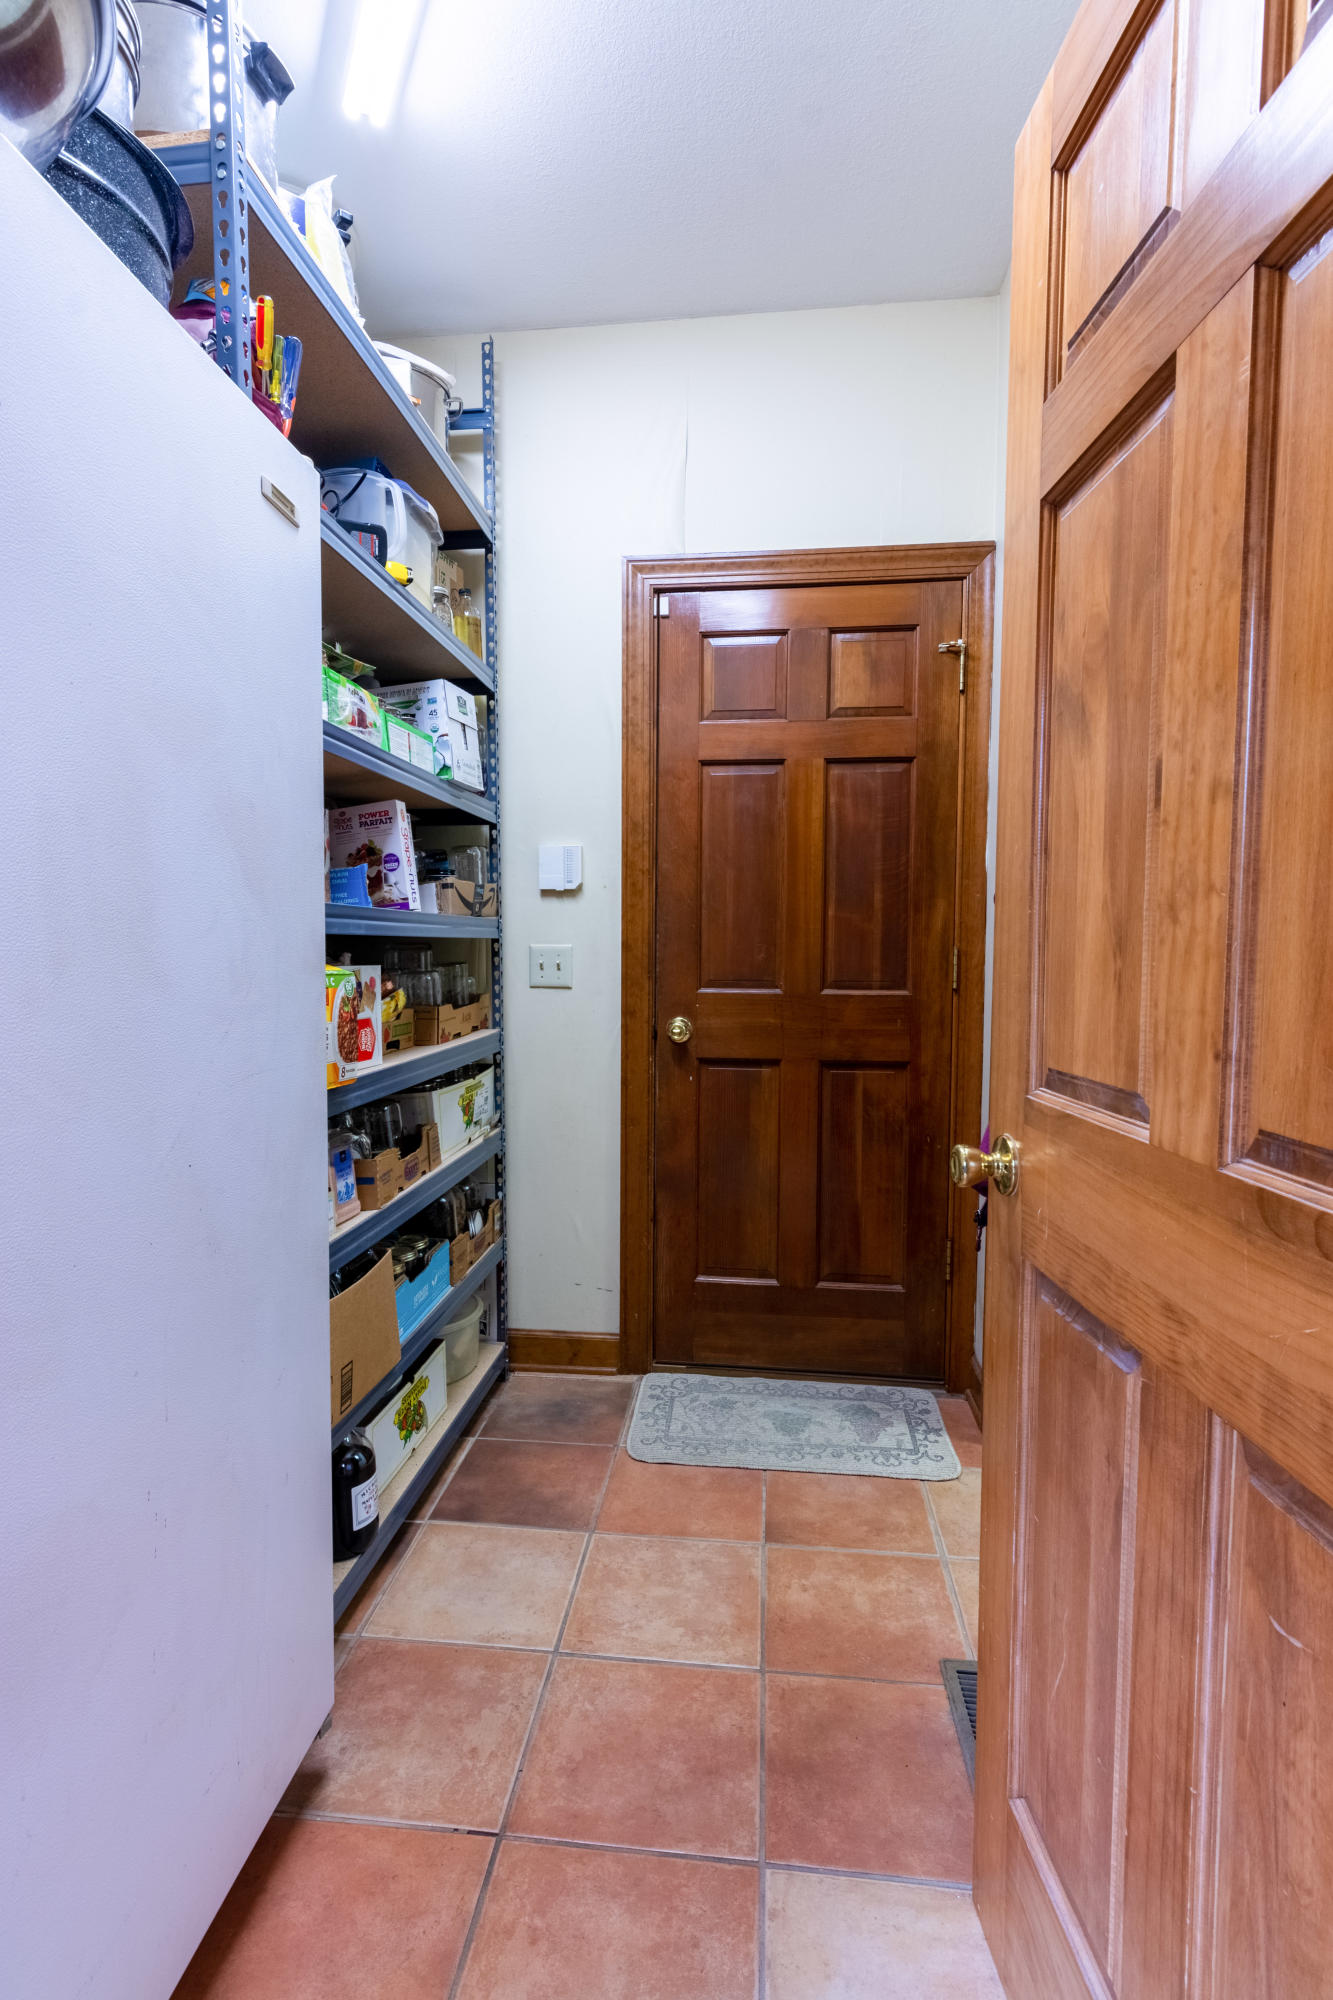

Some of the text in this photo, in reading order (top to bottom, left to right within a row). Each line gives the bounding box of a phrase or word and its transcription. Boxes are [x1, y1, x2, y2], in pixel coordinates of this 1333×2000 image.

[358, 810, 390, 821] POWER
[359, 817, 393, 828] PARFAIT
[340, 1066, 346, 1078] 8
